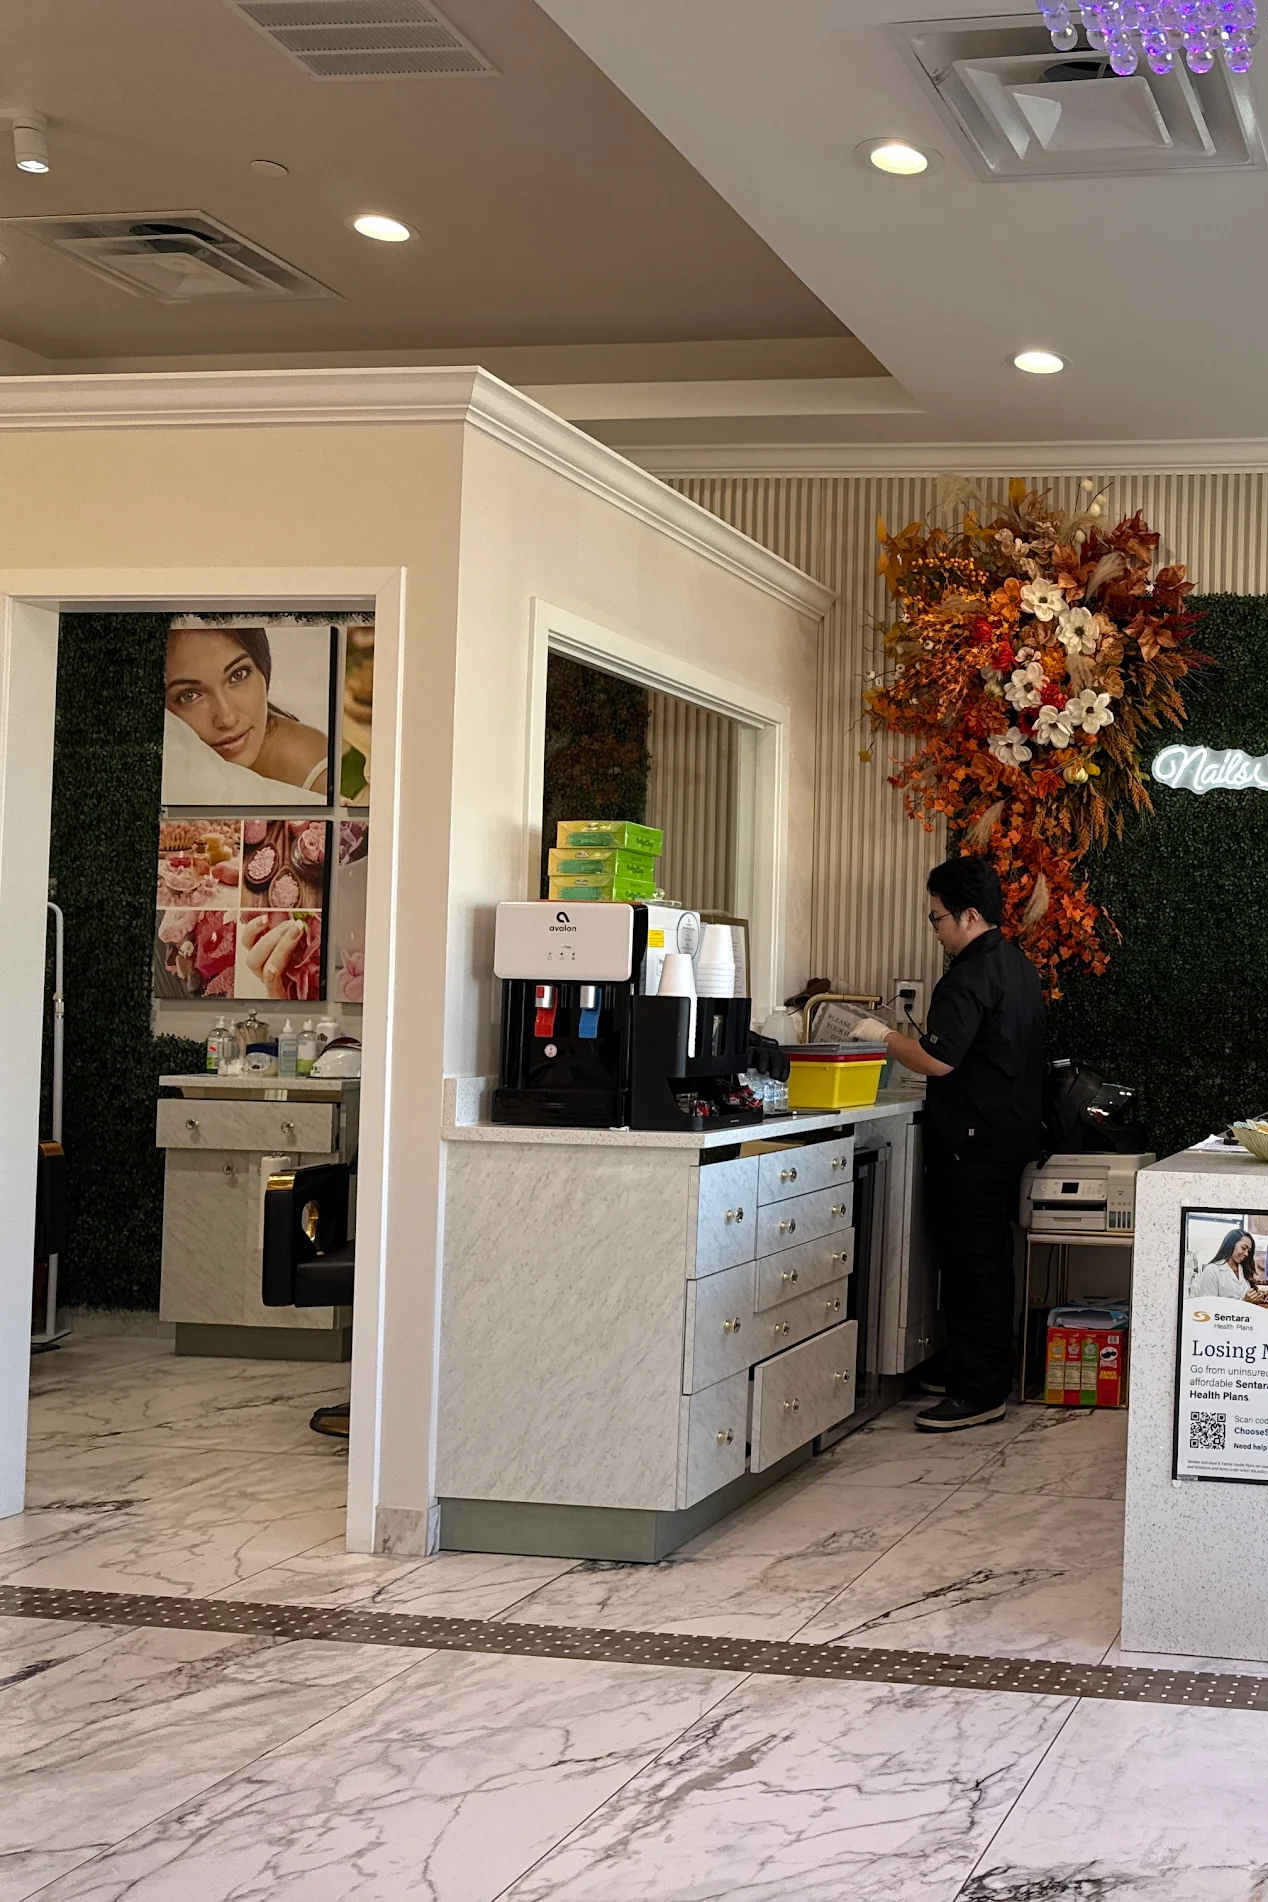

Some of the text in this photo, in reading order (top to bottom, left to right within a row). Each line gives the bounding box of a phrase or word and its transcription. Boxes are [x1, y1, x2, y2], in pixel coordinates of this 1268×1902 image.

[1155, 747, 1252, 793] Nails
[549, 924, 577, 932] avalon
[1213, 1313, 1250, 1323] Sentara
[1213, 1323, 1234, 1331] Health
[1192, 1340, 1257, 1363] Losing
[1190, 1365, 1203, 1374] Go
[1205, 1365, 1225, 1375] from
[1190, 1378, 1233, 1388] affordable
[1189, 1390, 1220, 1400] Health
[1234, 1415, 1253, 1424] Scan
